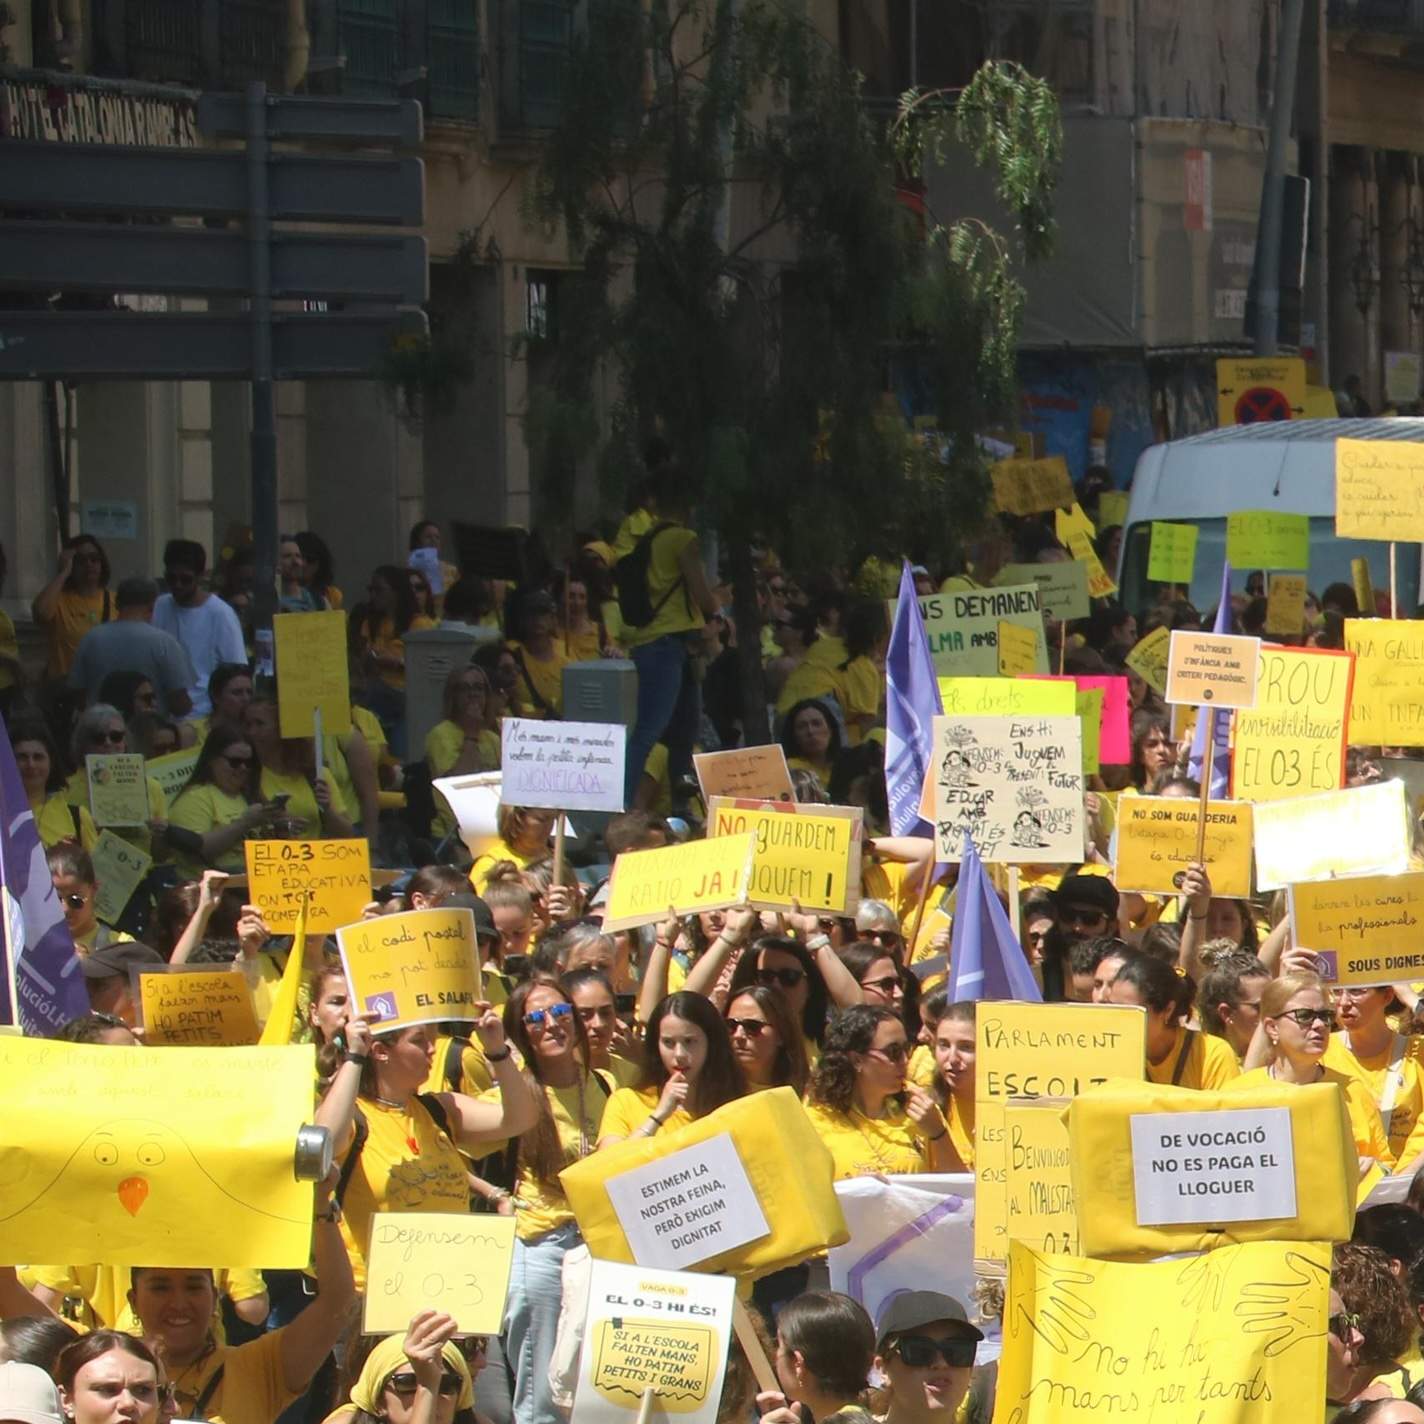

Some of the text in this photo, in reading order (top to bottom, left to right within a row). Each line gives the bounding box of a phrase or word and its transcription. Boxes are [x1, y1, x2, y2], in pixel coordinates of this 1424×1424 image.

[954, 591, 1040, 618] DEMANEN
[971, 631, 997, 647] AMB
[1132, 809, 1173, 823] NO SOM
[255, 845, 361, 861] EL 0-3 SOM
[254, 864, 310, 877] ETAPA
[281, 875, 368, 890] EDUCATIVA
[1347, 957, 1381, 974] SOUS
[1160, 1126, 1267, 1149] DE VOCACIÓ
[1152, 1151, 1279, 1173] NO ES PAGA EL
[640, 1163, 709, 1198] ESTIMEM LA
[1177, 1179, 1255, 1197] LLOGUER
[640, 1179, 726, 1220] NOSTRA FEINA,
[655, 1199, 726, 1236] PERÒ EXIGIM
[376, 1222, 507, 1268] Defensem
[671, 1221, 723, 1250] DIGNITAT
